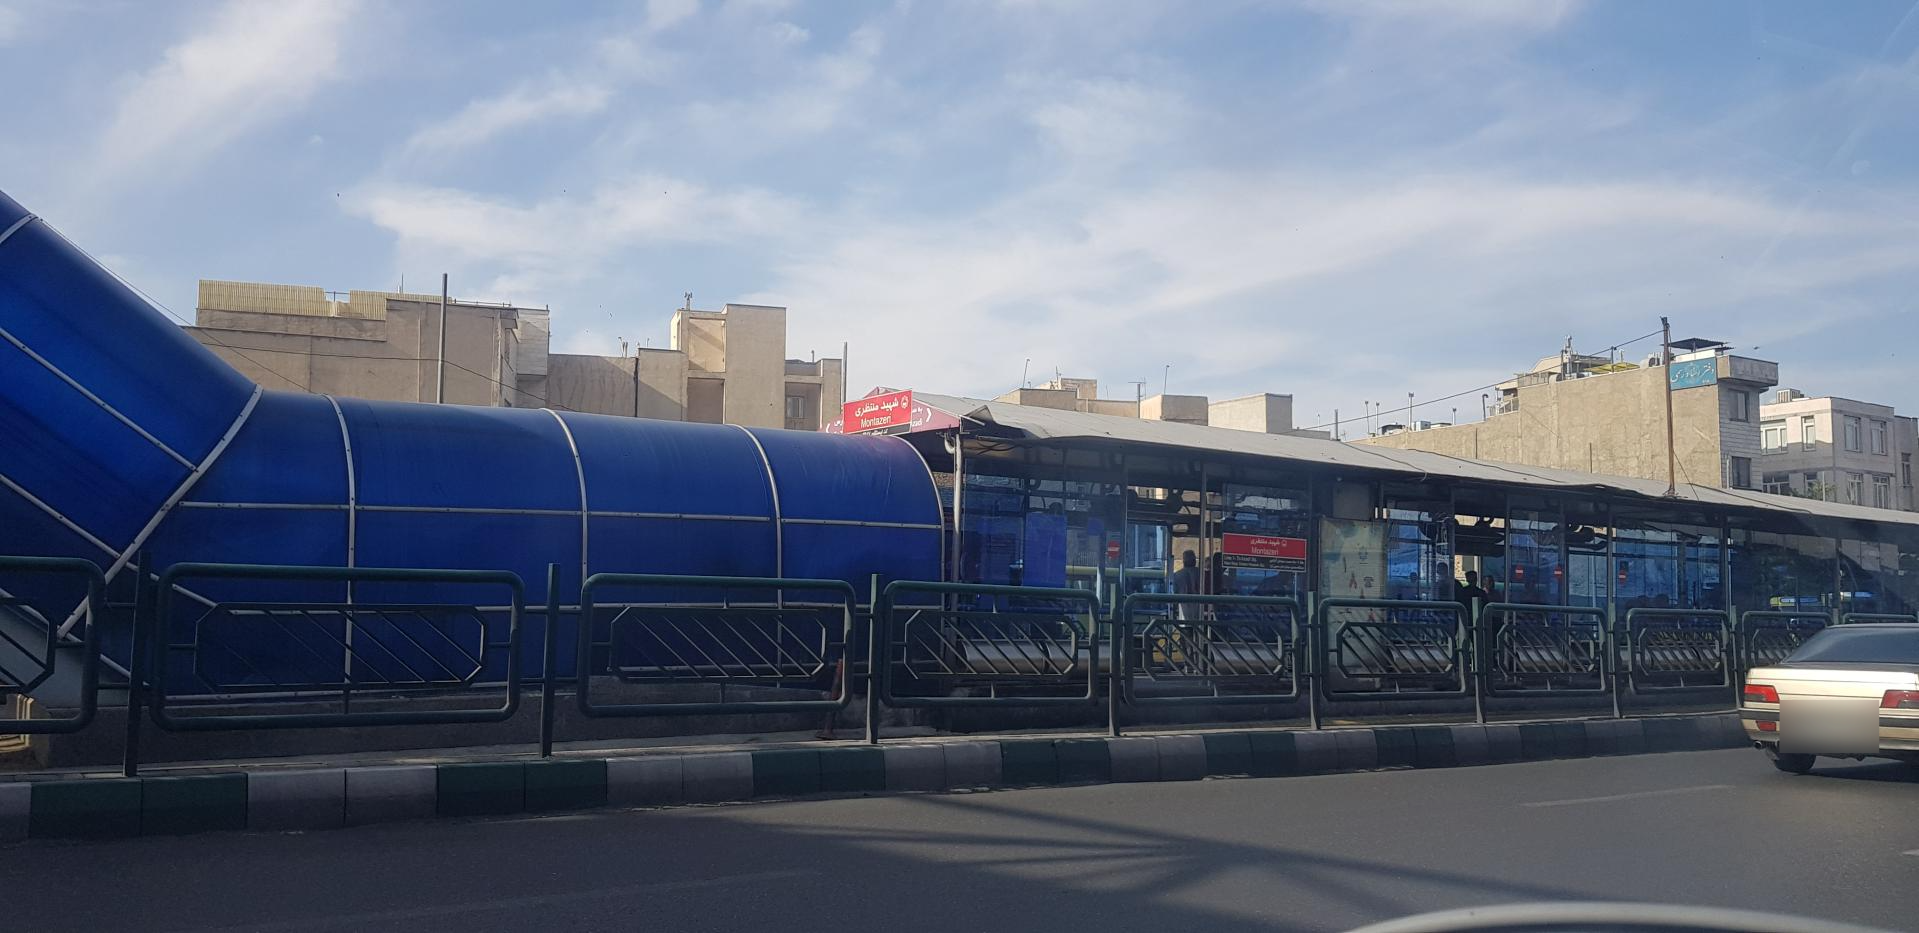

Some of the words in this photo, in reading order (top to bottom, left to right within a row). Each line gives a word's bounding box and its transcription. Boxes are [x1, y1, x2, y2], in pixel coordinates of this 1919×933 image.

[855, 403, 878, 416] منتظری
[881, 397, 898, 411] شهید
[861, 413, 891, 428] Montazeri
[1252, 546, 1278, 555] Montazeri
